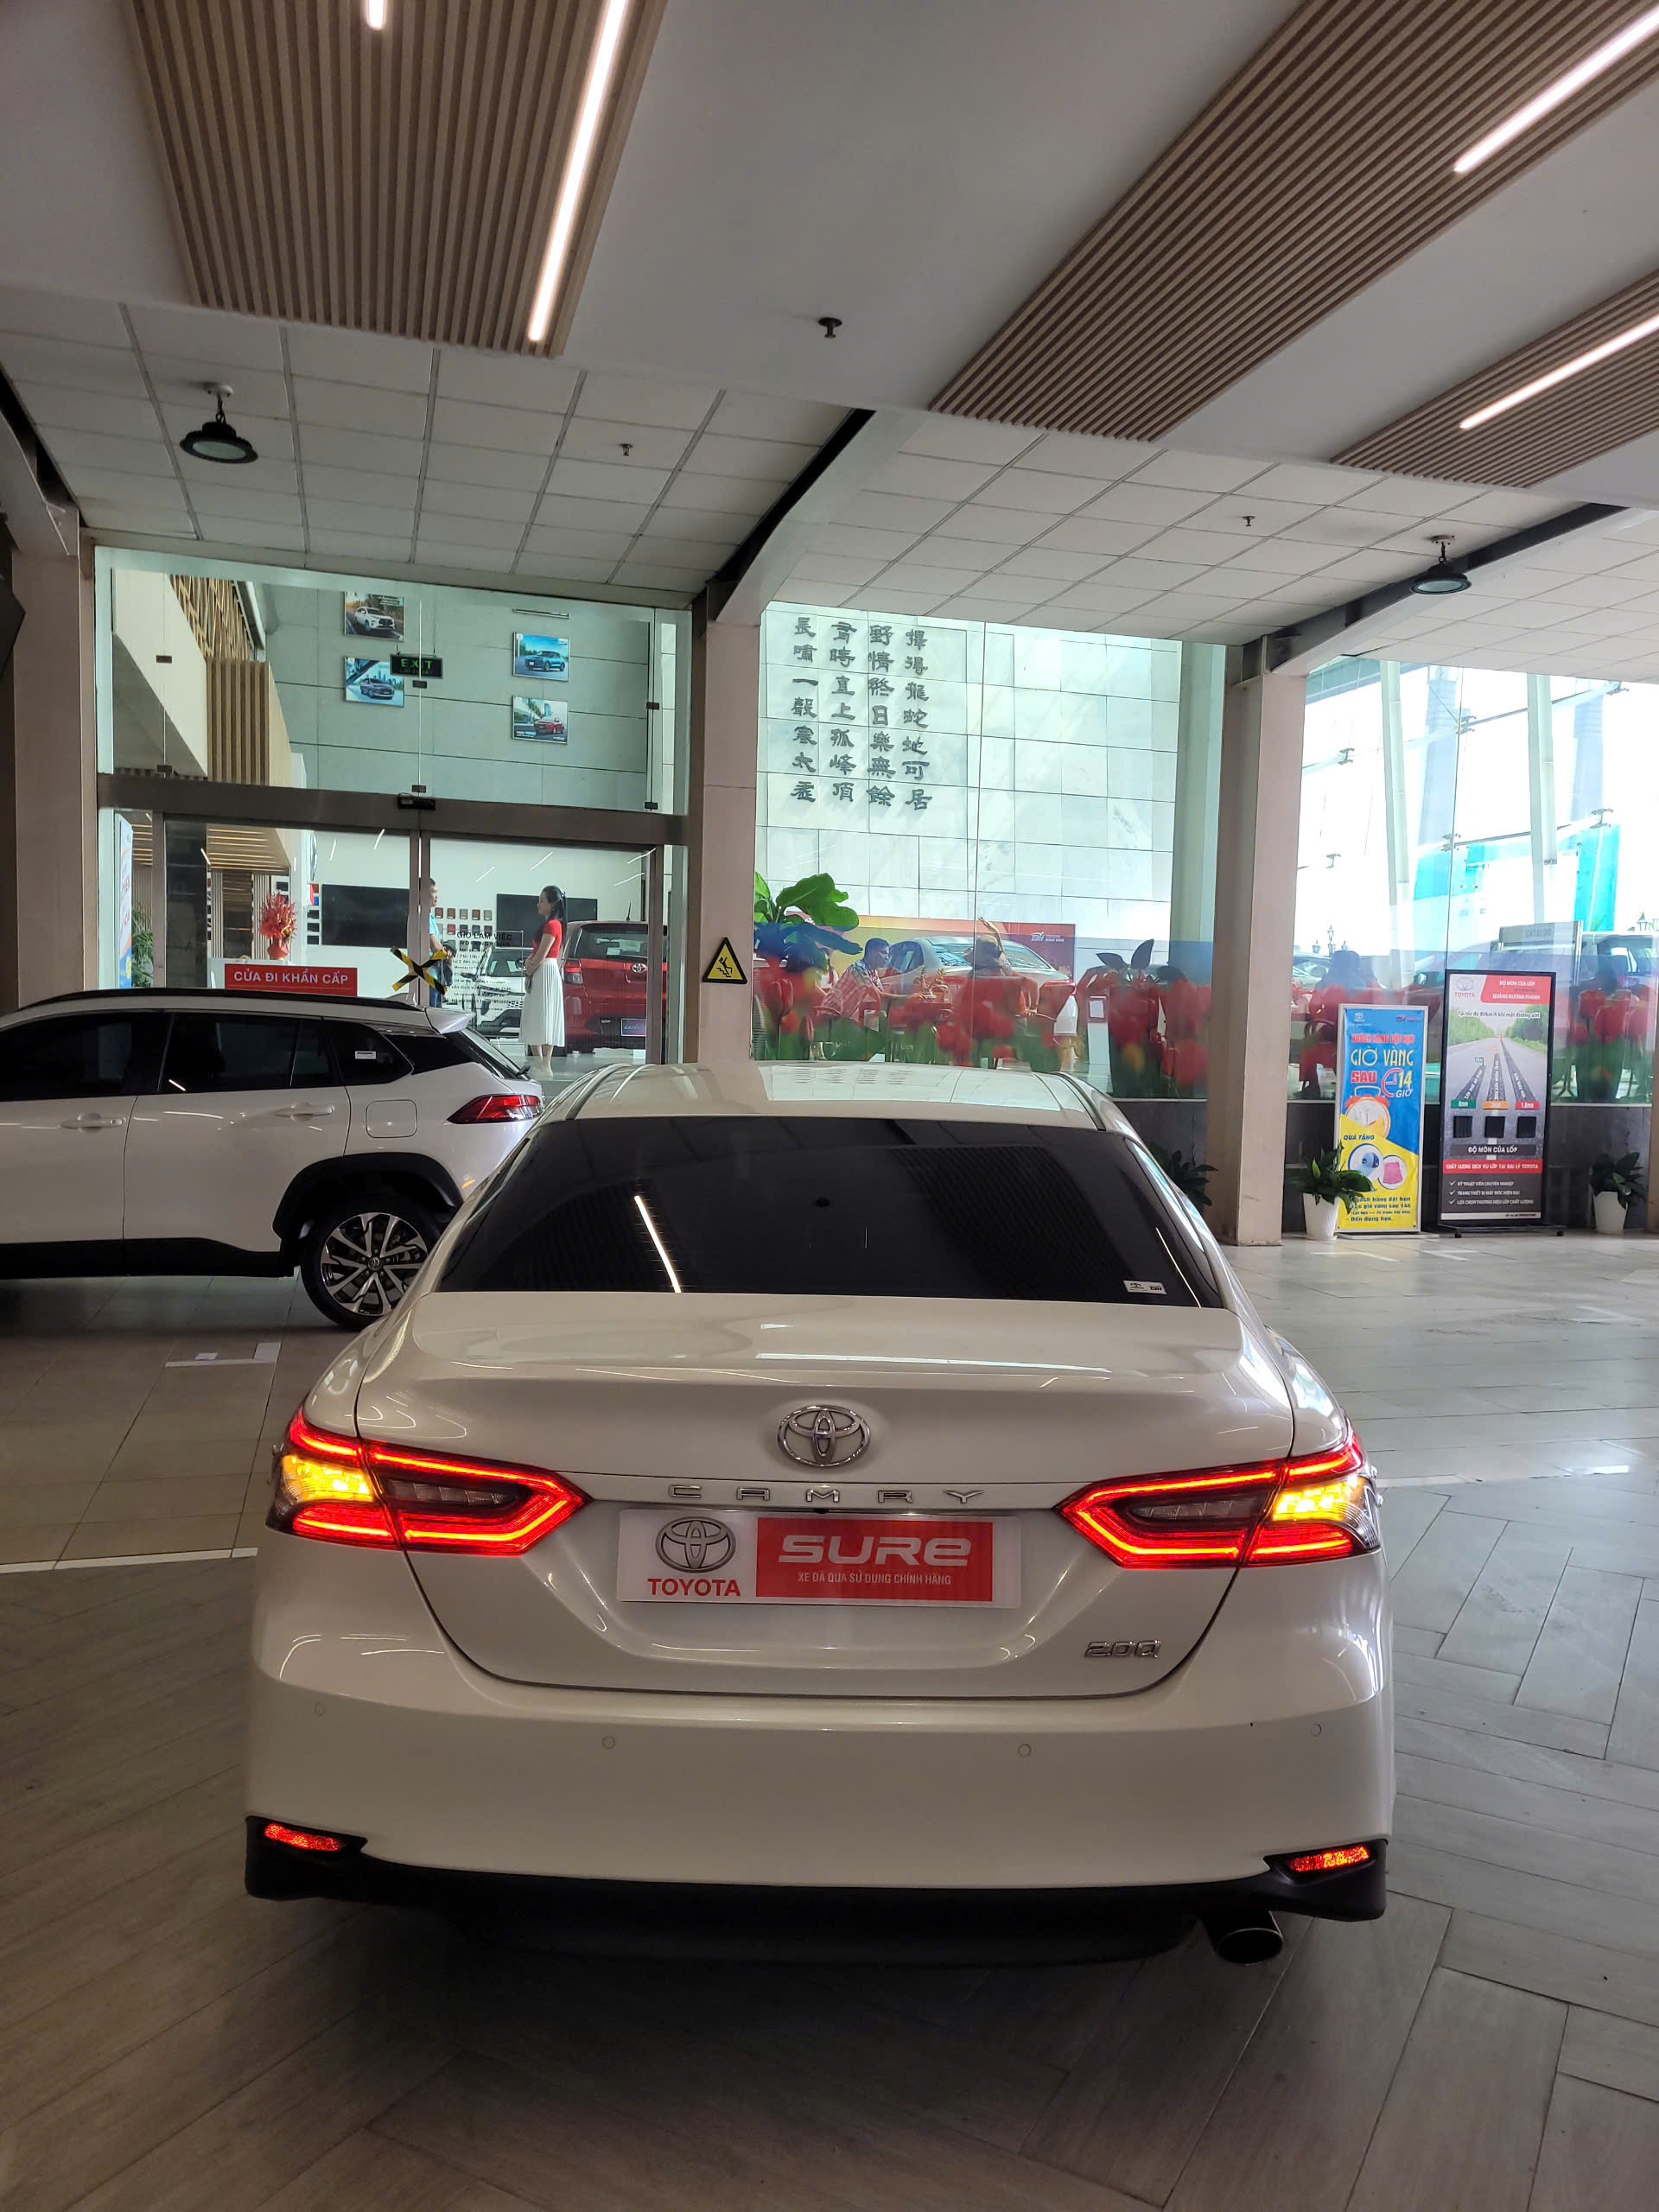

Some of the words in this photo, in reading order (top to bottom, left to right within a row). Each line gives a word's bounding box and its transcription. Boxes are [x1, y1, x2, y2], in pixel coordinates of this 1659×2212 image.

[234, 968, 262, 982] CỬA
[264, 972, 278, 982] ĐI
[282, 969, 318, 983] KHẨN
[322, 970, 348, 984] CẤP
[1351, 1046, 1378, 1066] GIỜ
[1383, 1046, 1414, 1066] VÀNG
[1351, 1071, 1377, 1084] SAU
[1398, 1071, 1413, 1089] 14
[1468, 1146, 1478, 1154] ĐỘ
[1493, 1145, 1505, 1154] CỦA
[1506, 1145, 1518, 1154] LỐP
[669, 1484, 984, 1504] CAMRY
[798, 1572, 810, 1582] XE
[828, 1572, 847, 1584] QUA
[893, 1570, 923, 1585] CHÍNH
[647, 1578, 741, 1597] TOYOTA
